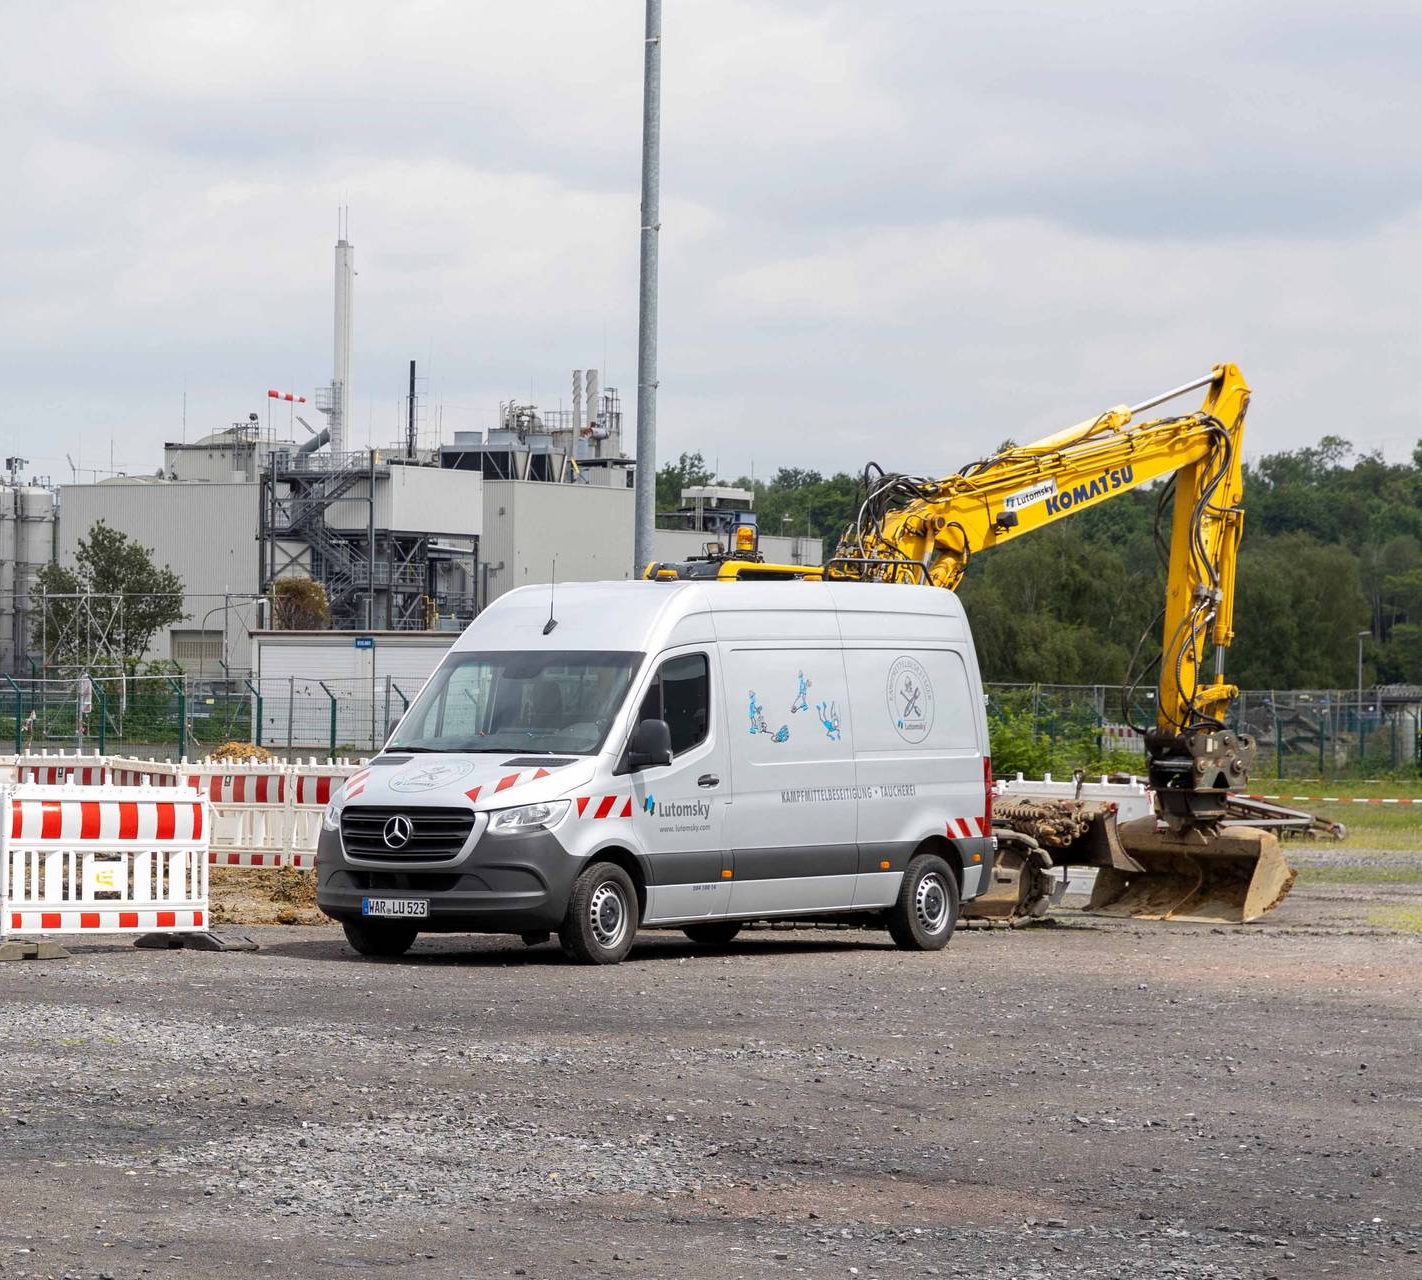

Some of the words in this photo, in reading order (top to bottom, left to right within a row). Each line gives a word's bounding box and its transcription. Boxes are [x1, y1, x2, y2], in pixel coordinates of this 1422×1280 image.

[1016, 483, 1054, 506] Lutomsky
[1045, 464, 1133, 516] KOMATSU
[781, 786, 873, 803] KAMPFMITTELBESEITIGUNG
[879, 784, 916, 797] TAUCHEREI
[659, 799, 710, 820] Lutomsky
[370, 900, 386, 914] WAR
[392, 901, 405, 914] LU
[407, 901, 425, 915] 523
